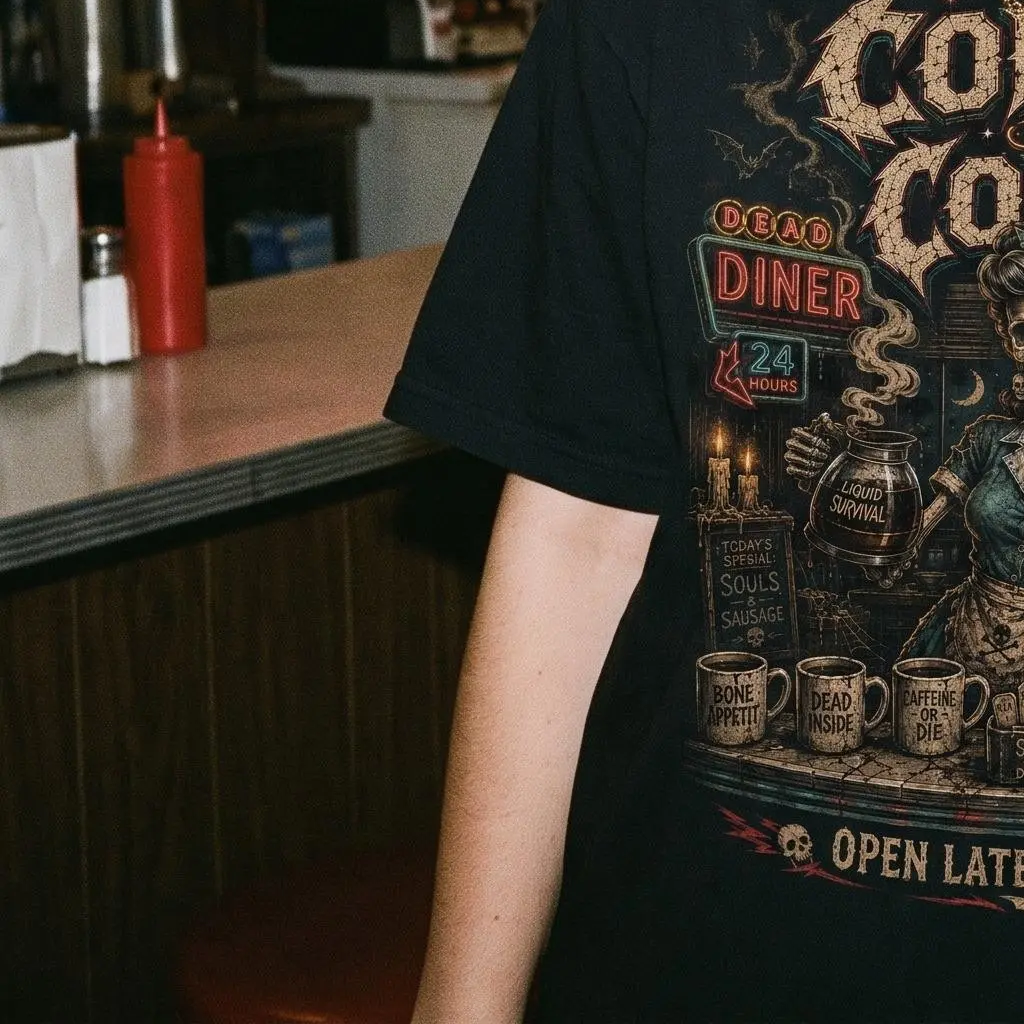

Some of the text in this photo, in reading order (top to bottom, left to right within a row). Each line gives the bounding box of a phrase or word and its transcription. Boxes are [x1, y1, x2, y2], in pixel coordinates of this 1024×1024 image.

[723, 206, 828, 244] DEAD
[717, 251, 861, 320] DINER
[750, 341, 795, 376] 24
[750, 377, 798, 393] HOURS
[841, 480, 883, 501] LIQUID
[829, 494, 886, 523] SURVIVAL
[720, 571, 780, 597] SOULS
[721, 606, 785, 629] SAUSAGE
[712, 684, 754, 704] BONE
[811, 691, 852, 712] DEAD
[903, 689, 957, 707] CAFFEINE
[708, 703, 760, 727] APPETIT
[808, 712, 854, 735] INSIDE
[920, 708, 938, 722] OR
[916, 722, 943, 742] DIE
[832, 826, 929, 883] OPEN
